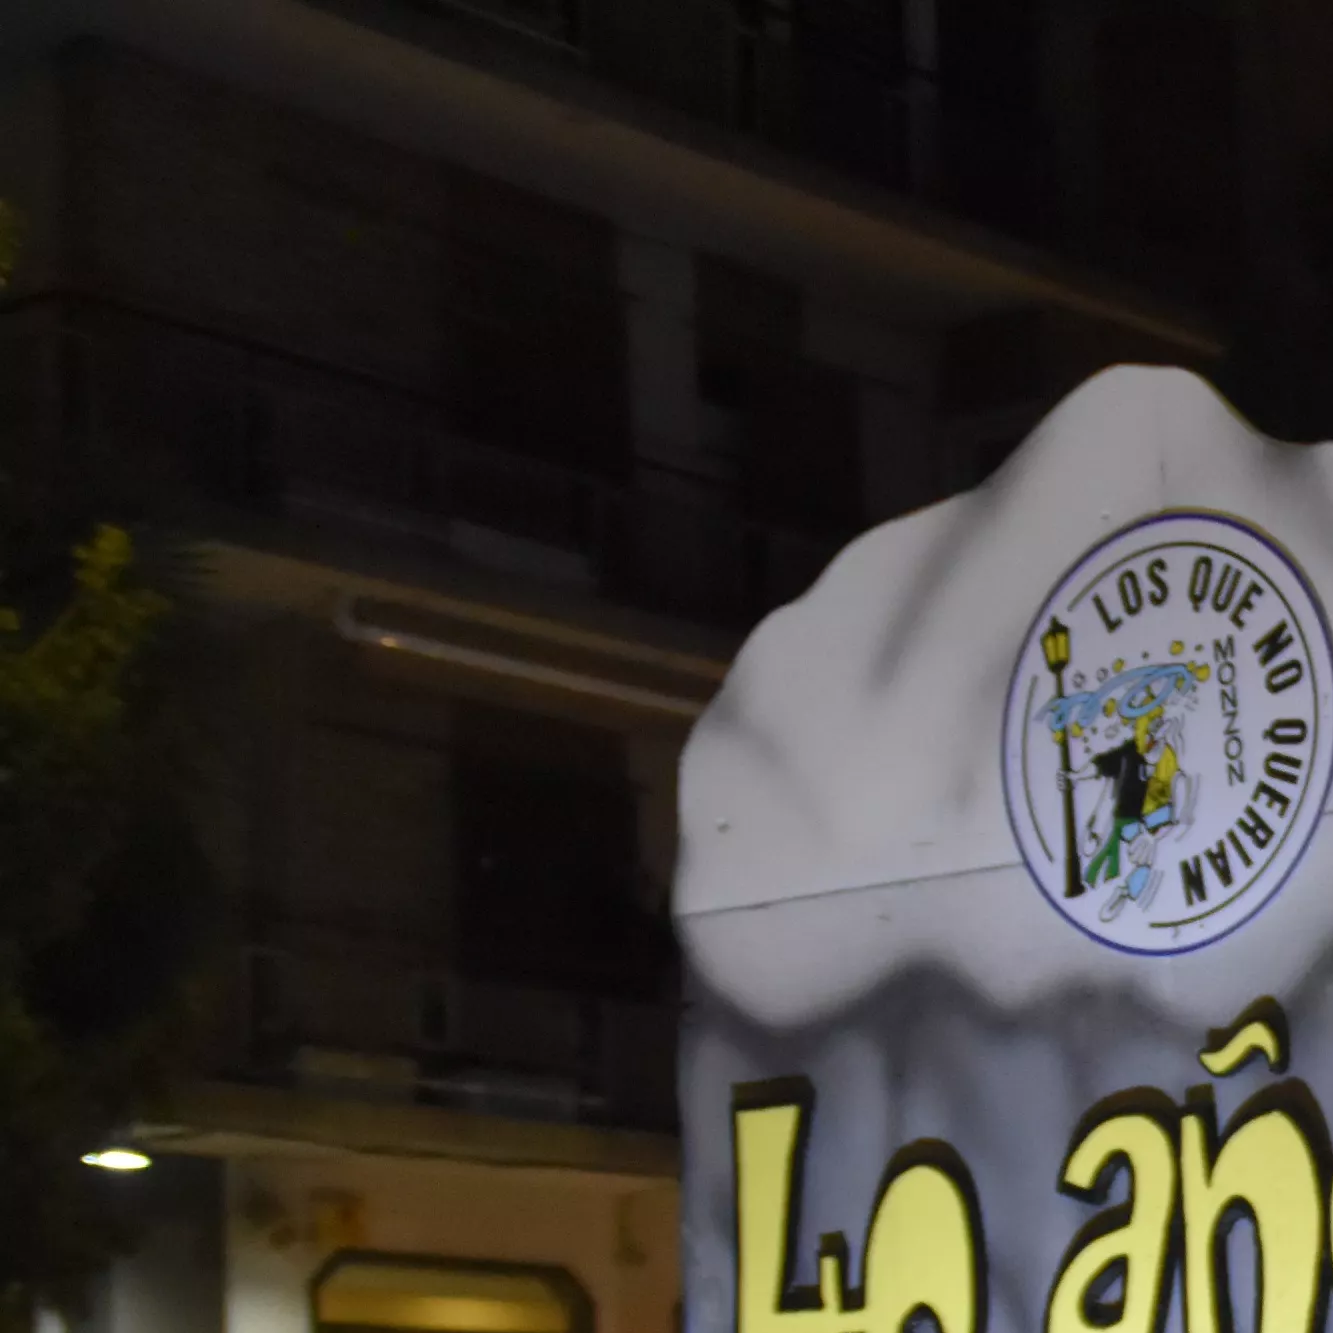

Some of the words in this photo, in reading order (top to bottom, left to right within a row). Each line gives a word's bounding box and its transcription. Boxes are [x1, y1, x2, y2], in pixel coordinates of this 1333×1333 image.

[1092, 557, 1169, 634] LOS
[1188, 555, 1265, 632] QUE
[1251, 618, 1303, 696] NO
[1213, 634, 1246, 787] MONZON
[1178, 718, 1308, 907] QUERIAN
